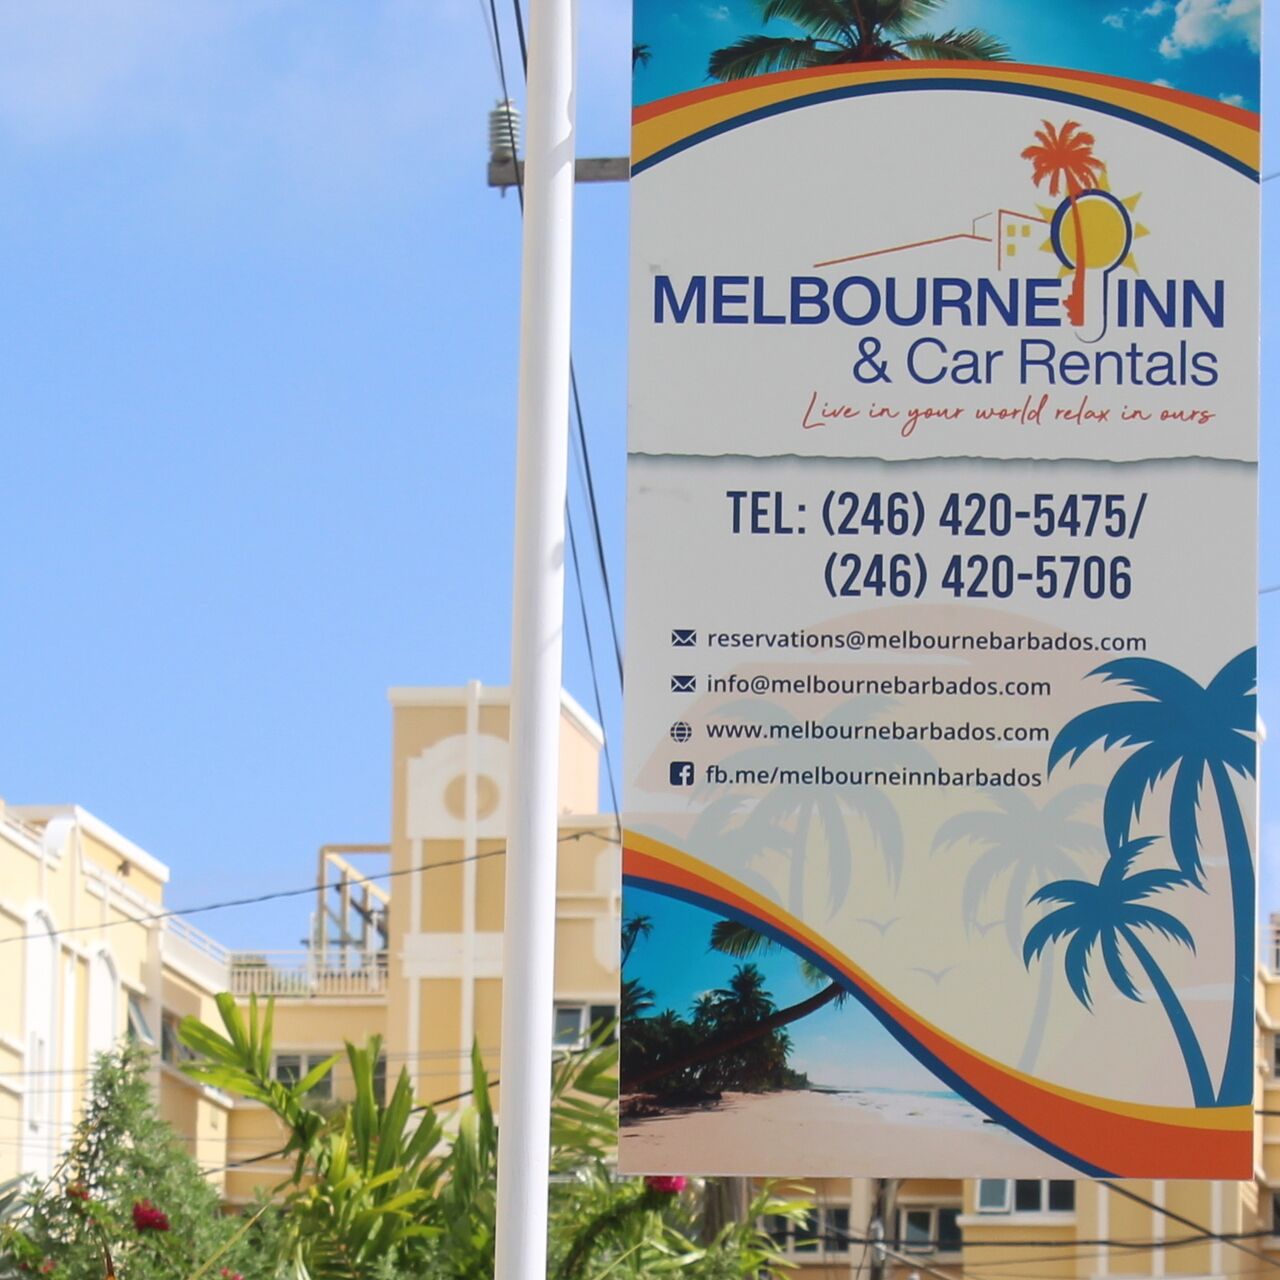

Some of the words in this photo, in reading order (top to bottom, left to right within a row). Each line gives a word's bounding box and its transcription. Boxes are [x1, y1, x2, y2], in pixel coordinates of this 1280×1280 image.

[653, 275, 1062, 327] MELBOURNE
[1117, 279, 1225, 328] INN
[852, 337, 893, 384] &
[906, 337, 1004, 385] Car
[1020, 339, 1219, 386] Rentals
[802, 391, 859, 429] Live
[869, 402, 899, 420] in
[901, 404, 969, 437] your
[975, 393, 1049, 424] world
[1055, 395, 1110, 423] relax
[1120, 402, 1151, 423] in
[1160, 408, 1216, 425] ours
[726, 490, 806, 535] TEL:
[822, 490, 925, 537] (246)
[938, 492, 1148, 540] 420-5475/
[824, 552, 928, 599] (246)
[941, 554, 1132, 600] 420-5706
[707, 629, 1148, 652] reservations@melbournebarbados.com
[706, 674, 1052, 697] info@melbournebarbados.com
[706, 720, 1050, 743] www.melbournebarbados.com
[705, 764, 1042, 788] fb.me/melbourneinnbarbados
